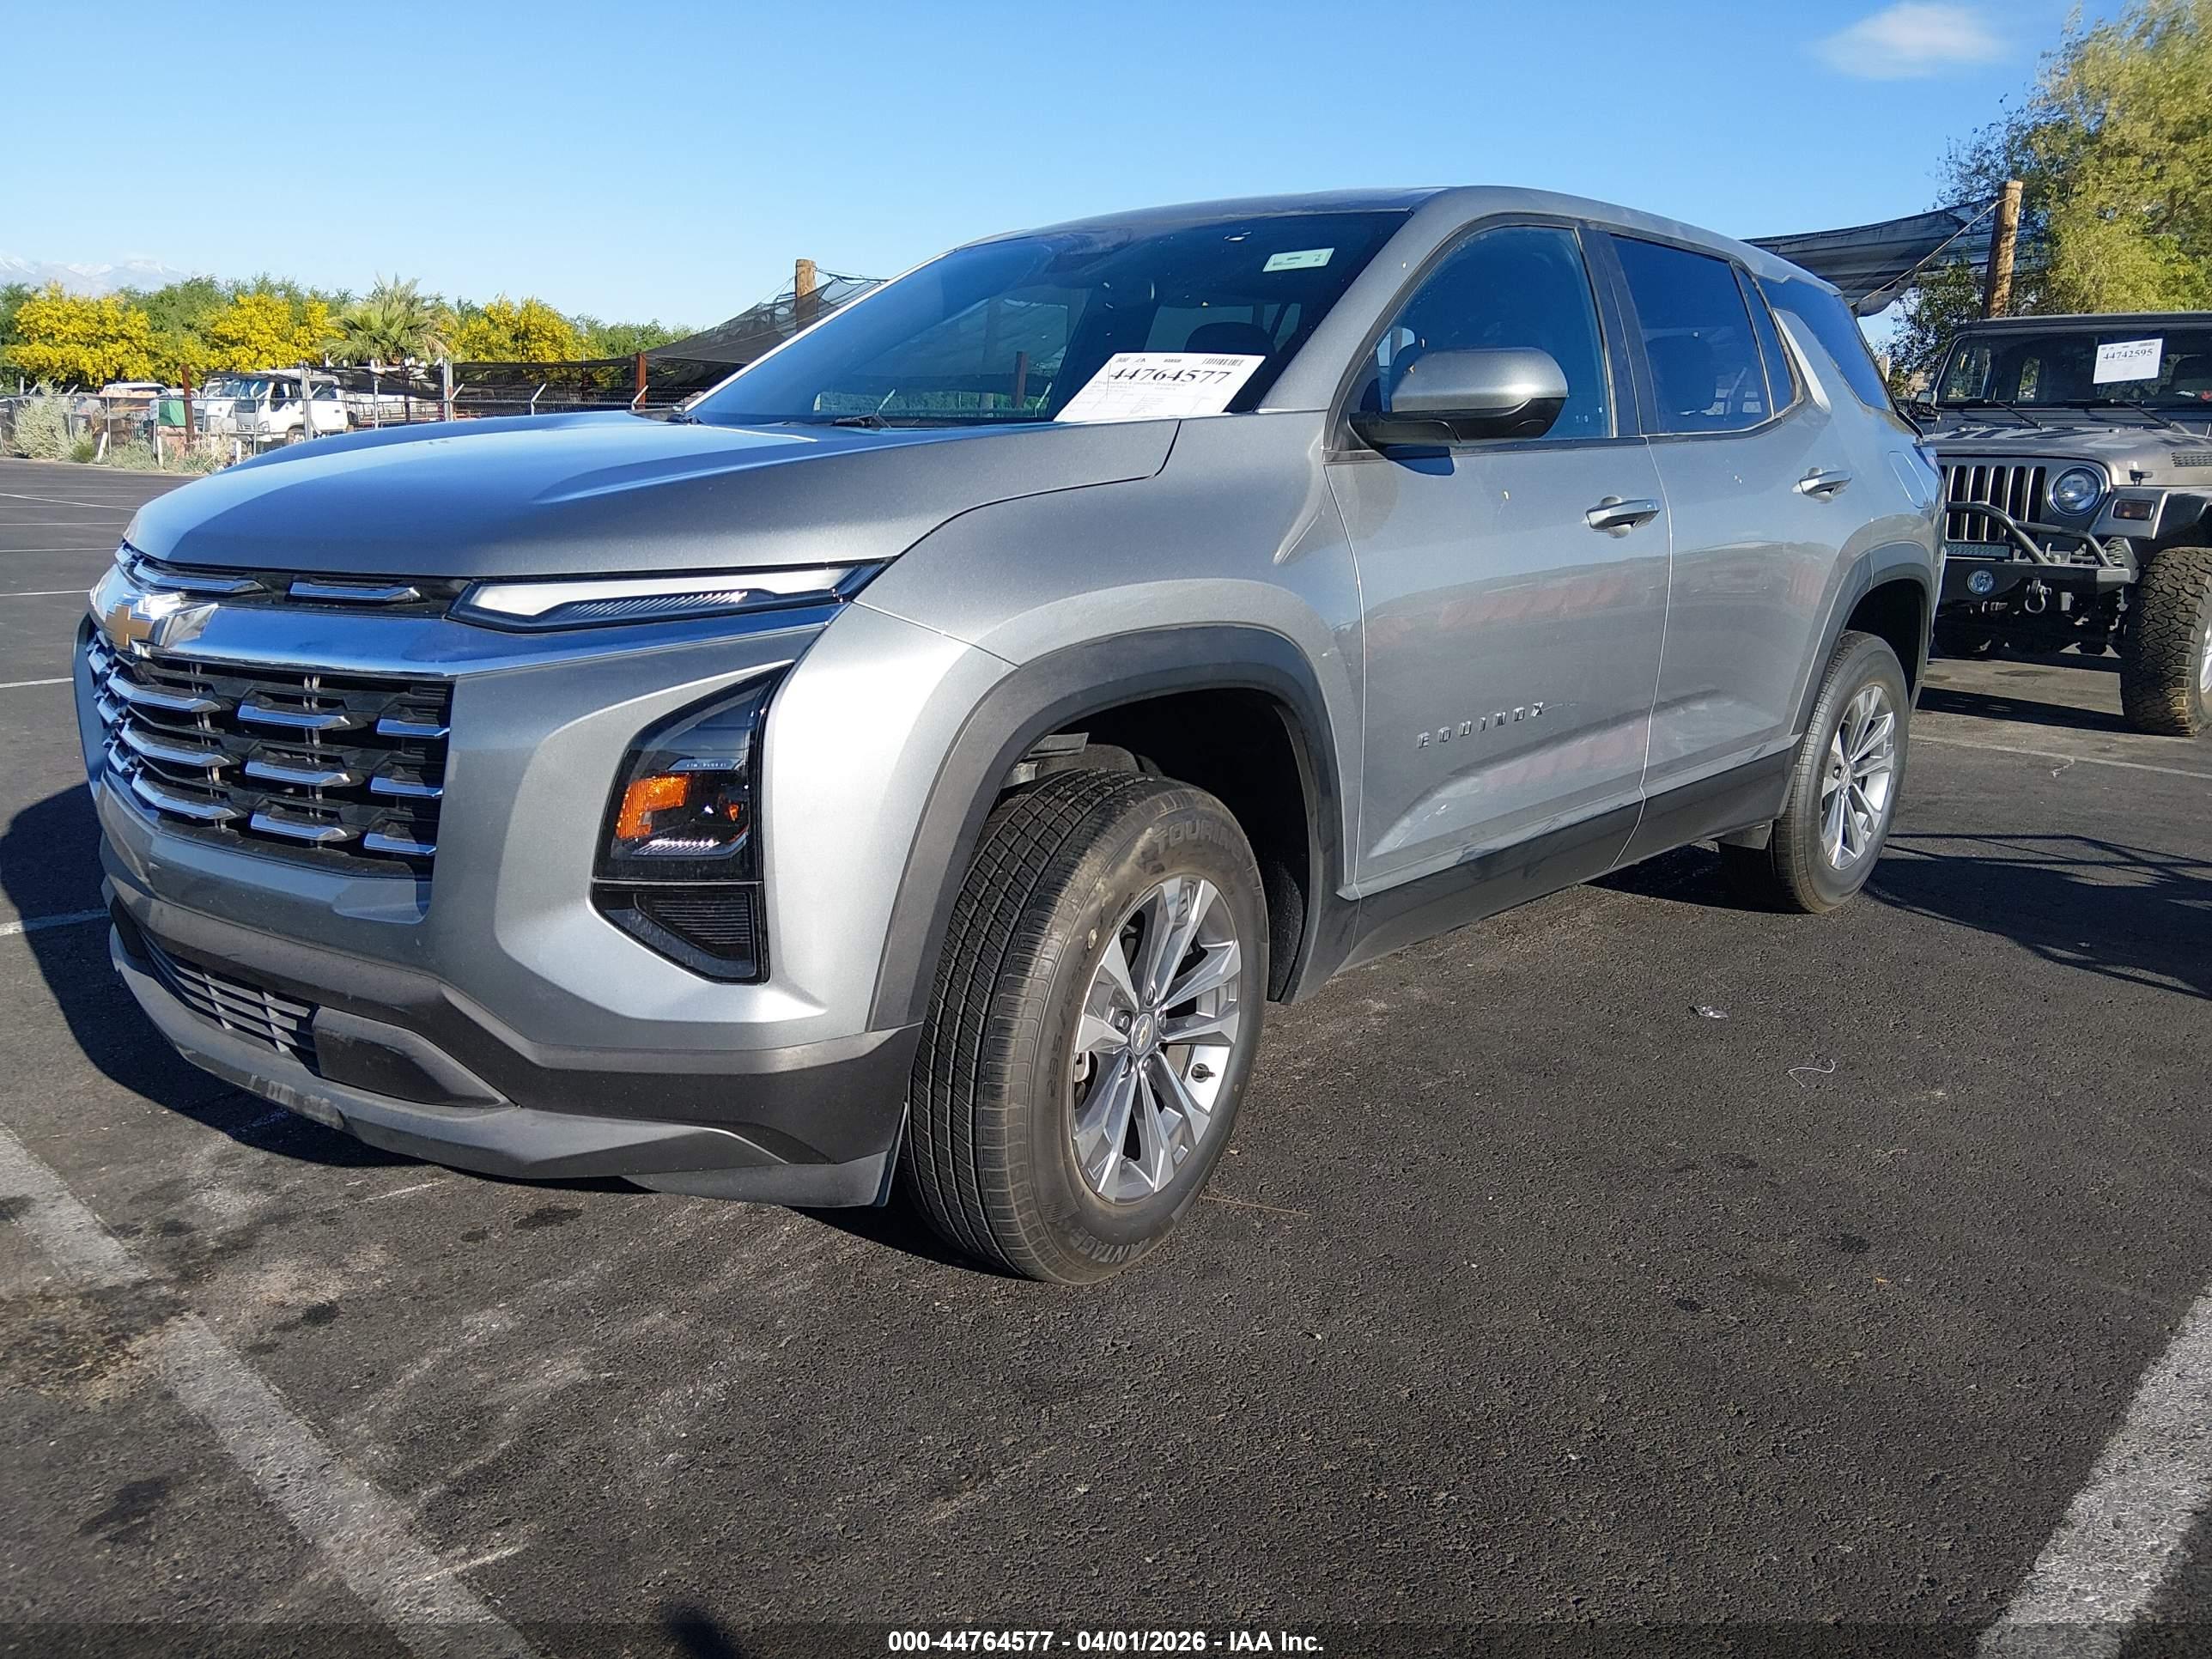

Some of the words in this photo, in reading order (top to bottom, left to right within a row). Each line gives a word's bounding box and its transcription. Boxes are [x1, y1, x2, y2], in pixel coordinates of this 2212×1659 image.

[2103, 348, 2154, 360] 44742595
[1109, 368, 1233, 385] 44764577
[1417, 702, 1544, 749] EQUINOX
